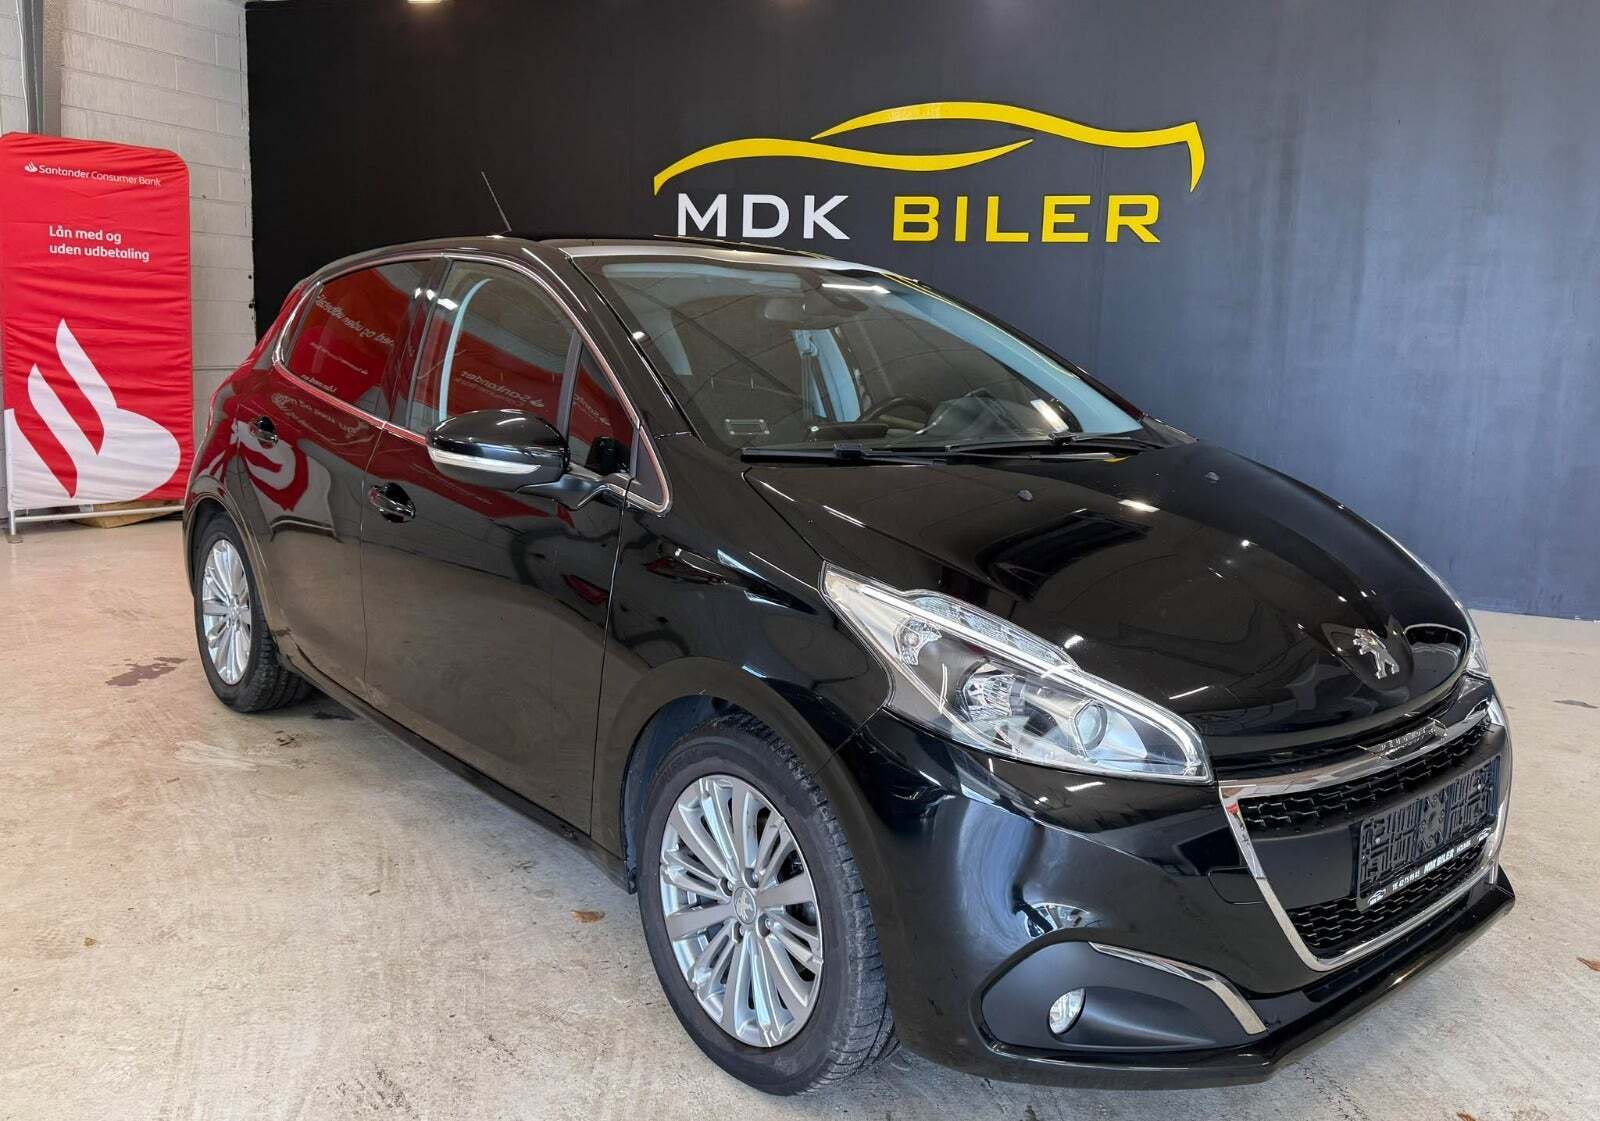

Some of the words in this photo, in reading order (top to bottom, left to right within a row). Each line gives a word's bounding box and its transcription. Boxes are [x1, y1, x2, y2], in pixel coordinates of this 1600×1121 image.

[39, 165, 89, 178] Santander
[91, 170, 137, 184] Consumer
[139, 175, 161, 186] Bank
[677, 193, 850, 240] MDK
[892, 195, 1160, 243] BILER
[49, 225, 72, 239] Lån
[75, 230, 103, 241] med
[105, 232, 121, 245] og
[49, 243, 81, 255] uden
[84, 246, 149, 263] udbetaling
